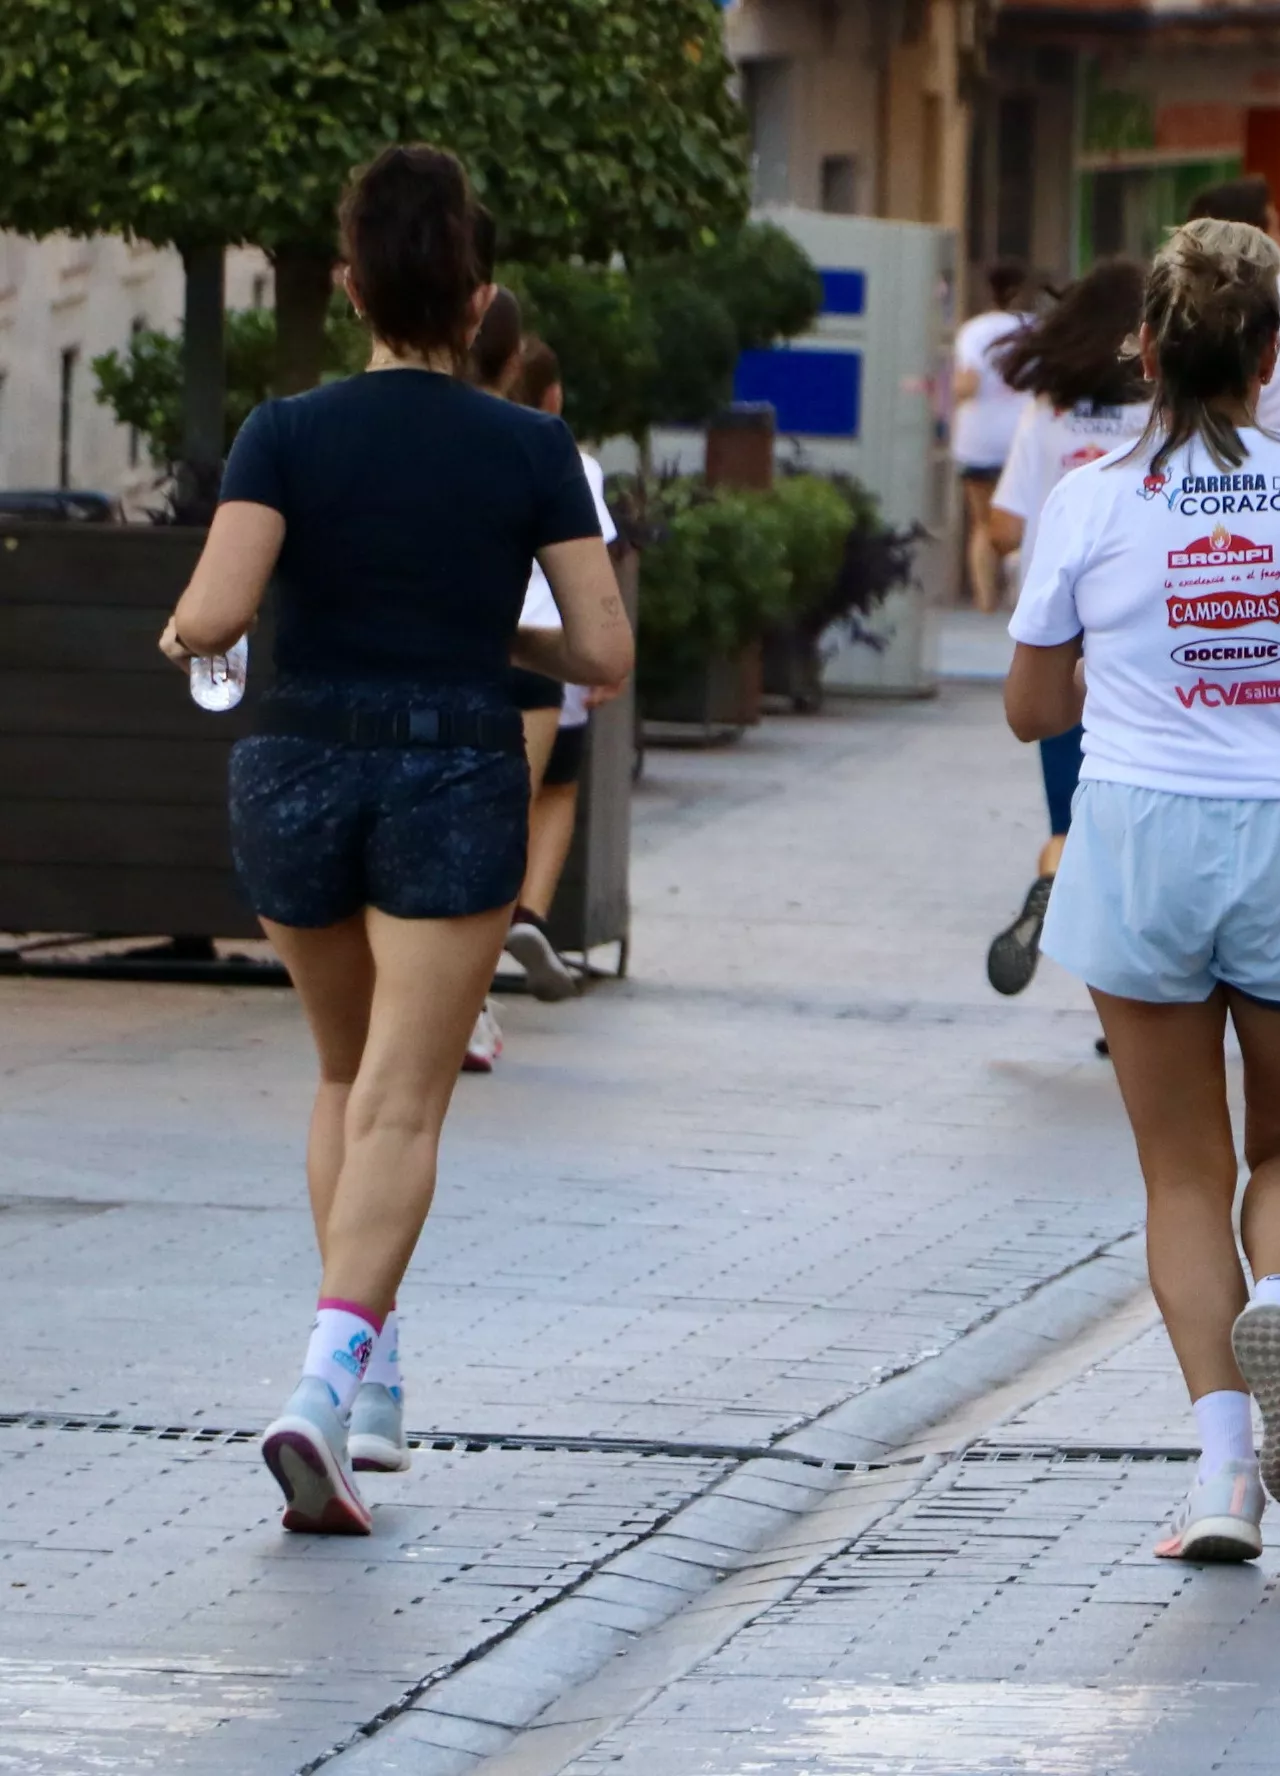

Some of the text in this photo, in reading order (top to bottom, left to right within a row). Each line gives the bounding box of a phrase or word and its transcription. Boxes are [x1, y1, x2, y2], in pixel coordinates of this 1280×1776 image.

[1181, 474, 1267, 494] CARRERA
[1171, 548, 1270, 566] BRONPI
[1172, 598, 1280, 622] CAMPOARAS
[1184, 645, 1279, 661] DOCRILUC
